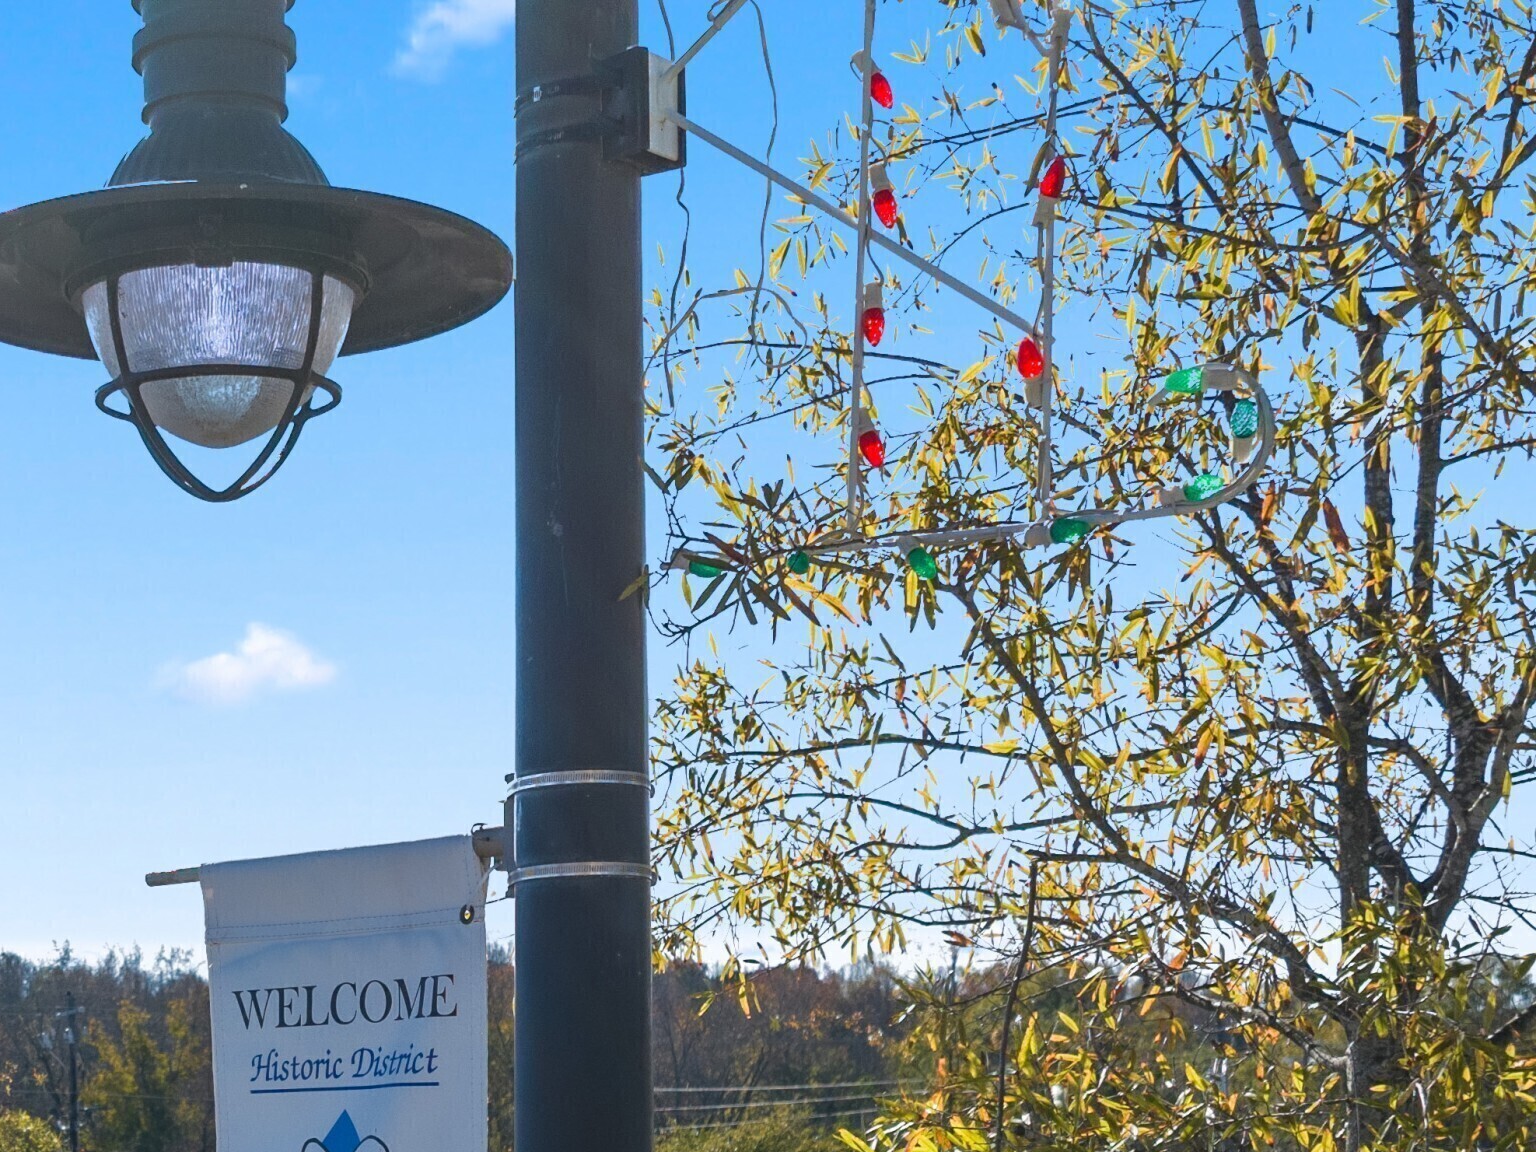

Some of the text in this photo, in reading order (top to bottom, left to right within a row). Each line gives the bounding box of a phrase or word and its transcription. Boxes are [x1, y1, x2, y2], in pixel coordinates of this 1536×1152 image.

[231, 973, 458, 1030] WELCOME
[249, 1043, 439, 1082] Historic District
